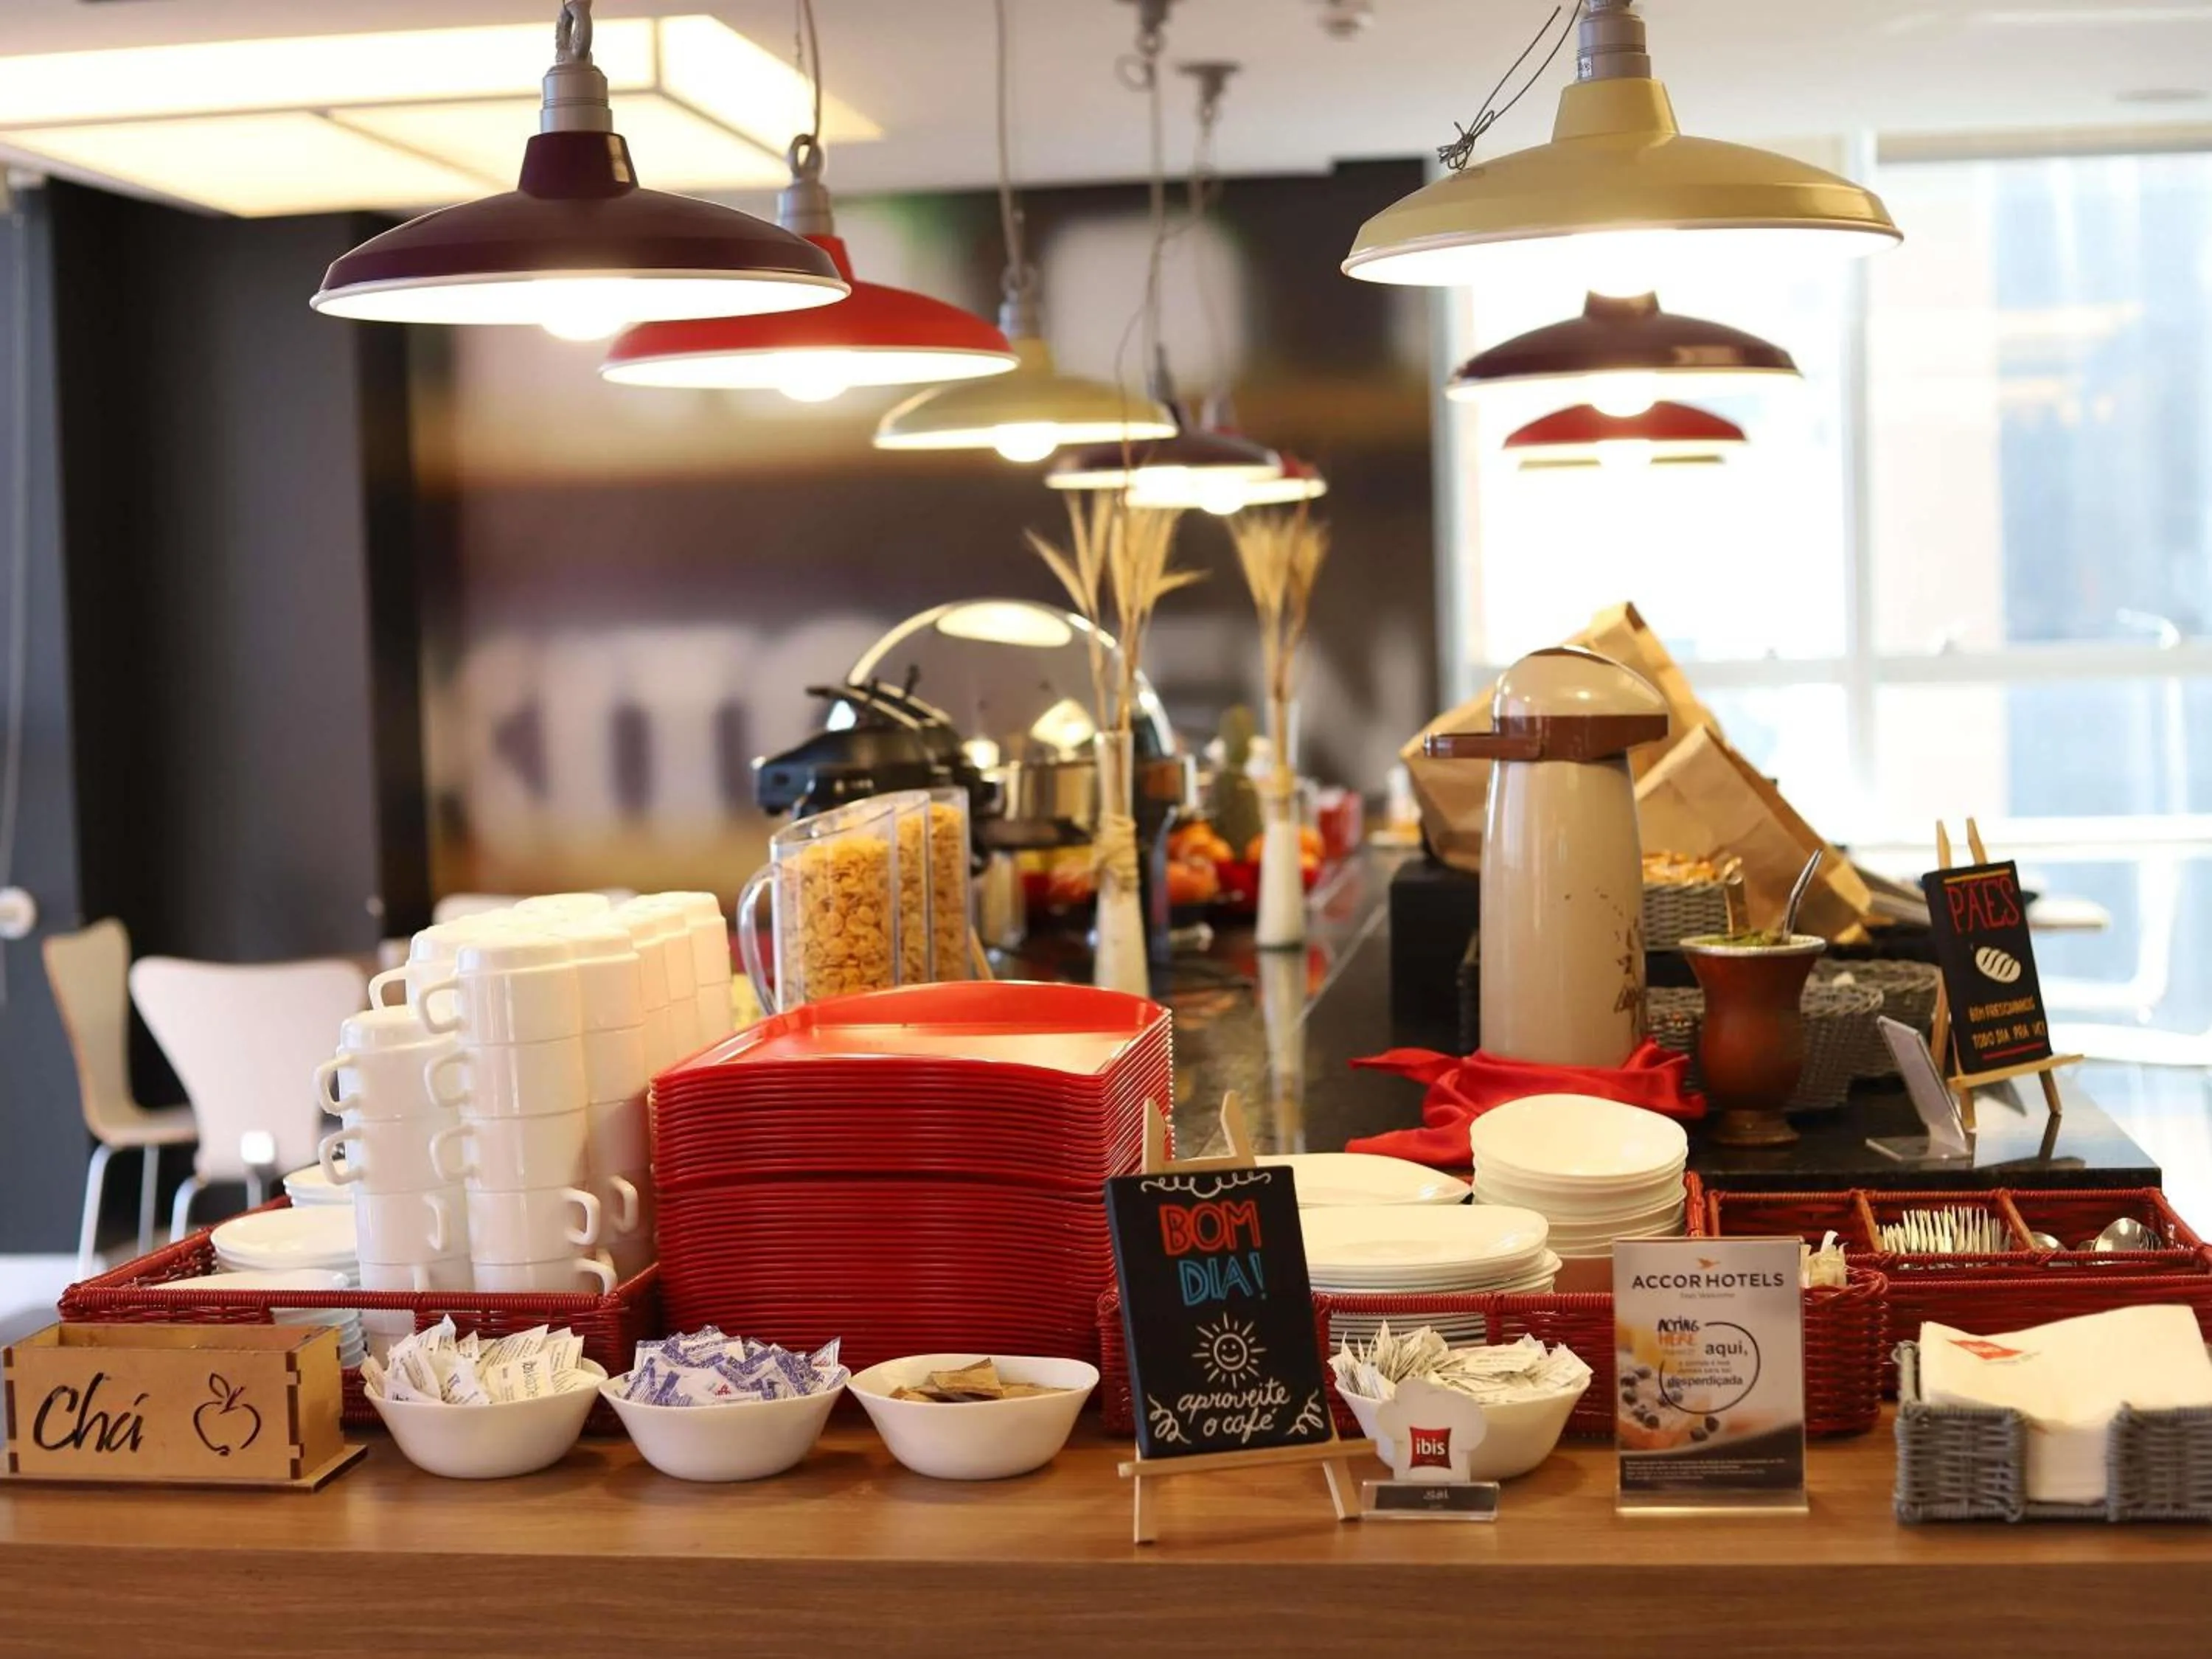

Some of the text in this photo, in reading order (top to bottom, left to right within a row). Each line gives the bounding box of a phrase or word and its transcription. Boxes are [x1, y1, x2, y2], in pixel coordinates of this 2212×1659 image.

[1158, 1200, 1262, 1256] BOM
[1178, 1252, 1268, 1307] DIA!
[1631, 1273, 1784, 1290] ACCOR HOTELS
[1705, 1340, 1748, 1357] aqui,
[1666, 1374, 1744, 1388] desperdiçada
[32, 1372, 150, 1453] Chá
[1177, 1377, 1291, 1424] aproveite
[1203, 1407, 1278, 1444] o café
[1416, 1438, 1446, 1455] ibis
